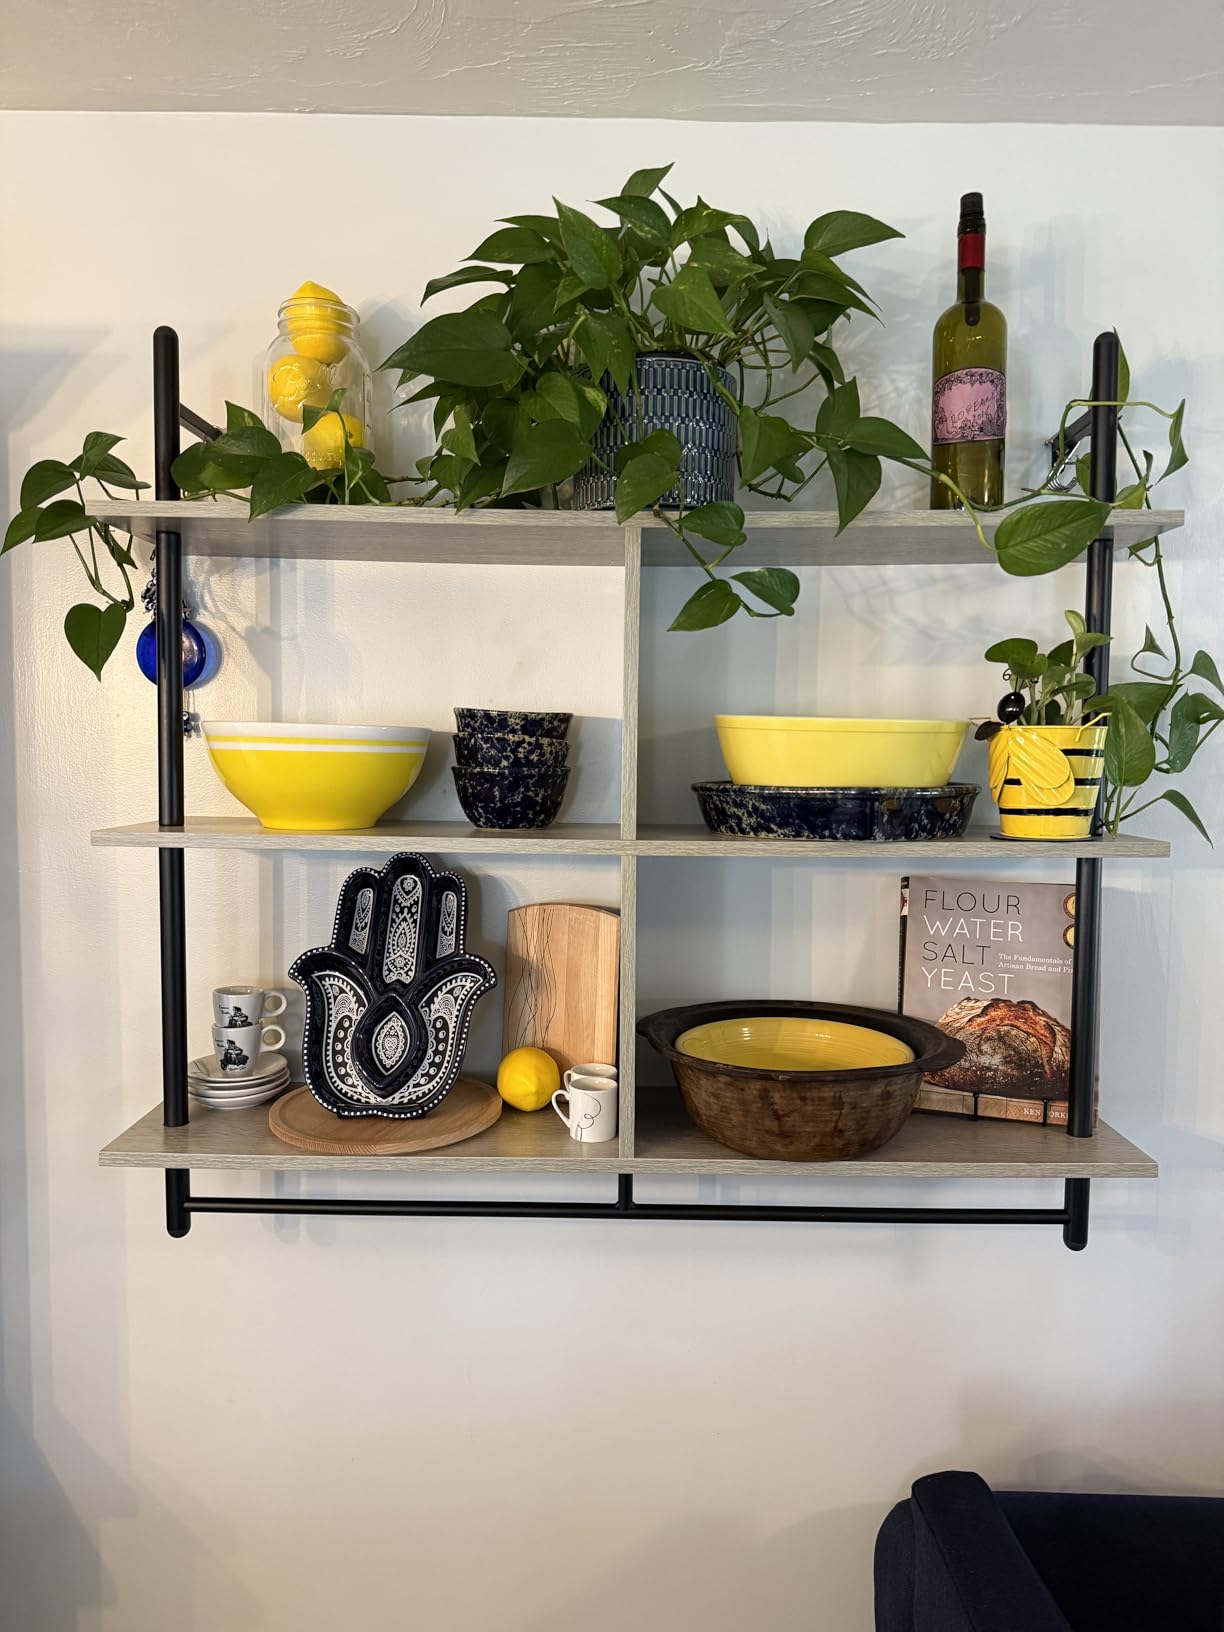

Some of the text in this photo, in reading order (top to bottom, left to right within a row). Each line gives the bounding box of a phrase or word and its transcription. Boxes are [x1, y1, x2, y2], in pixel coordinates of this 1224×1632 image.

[924, 889, 1021, 915] FLOUR
[923, 914, 1023, 942] WATER
[922, 940, 991, 966] SALT
[998, 953, 1012, 961] The
[1013, 954, 1063, 965] Fundamentals
[998, 961, 1024, 970] Artisan
[1025, 963, 1047, 972] Bread
[921, 966, 1015, 995] YEAST
[1023, 1107, 1041, 1116] KEN
